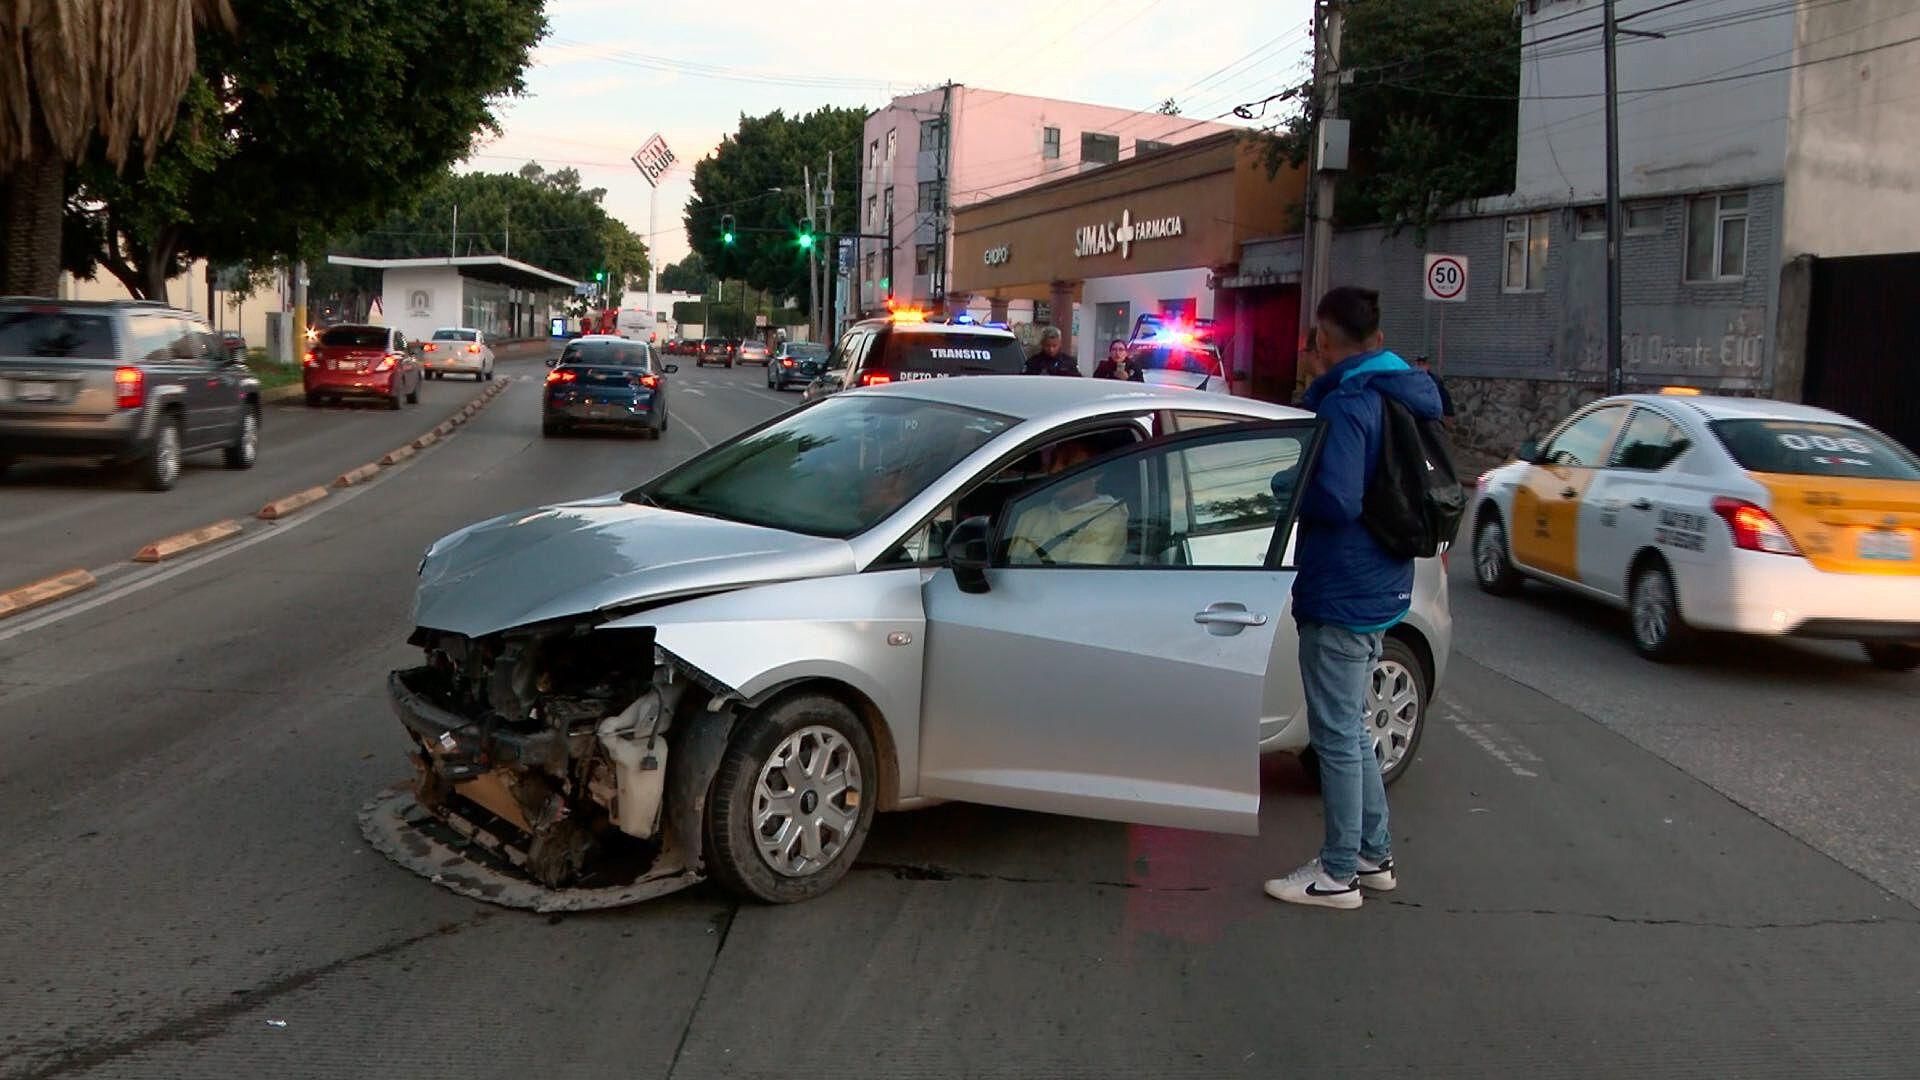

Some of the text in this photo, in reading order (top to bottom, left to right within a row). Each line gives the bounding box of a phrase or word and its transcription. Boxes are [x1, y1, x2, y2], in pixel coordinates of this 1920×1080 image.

[648, 149, 675, 179] CLUB
[1074, 215, 1182, 257] SIMAS FARMACIA
[1435, 266, 1457, 284] 50
[930, 348, 992, 360] TRANSITO
